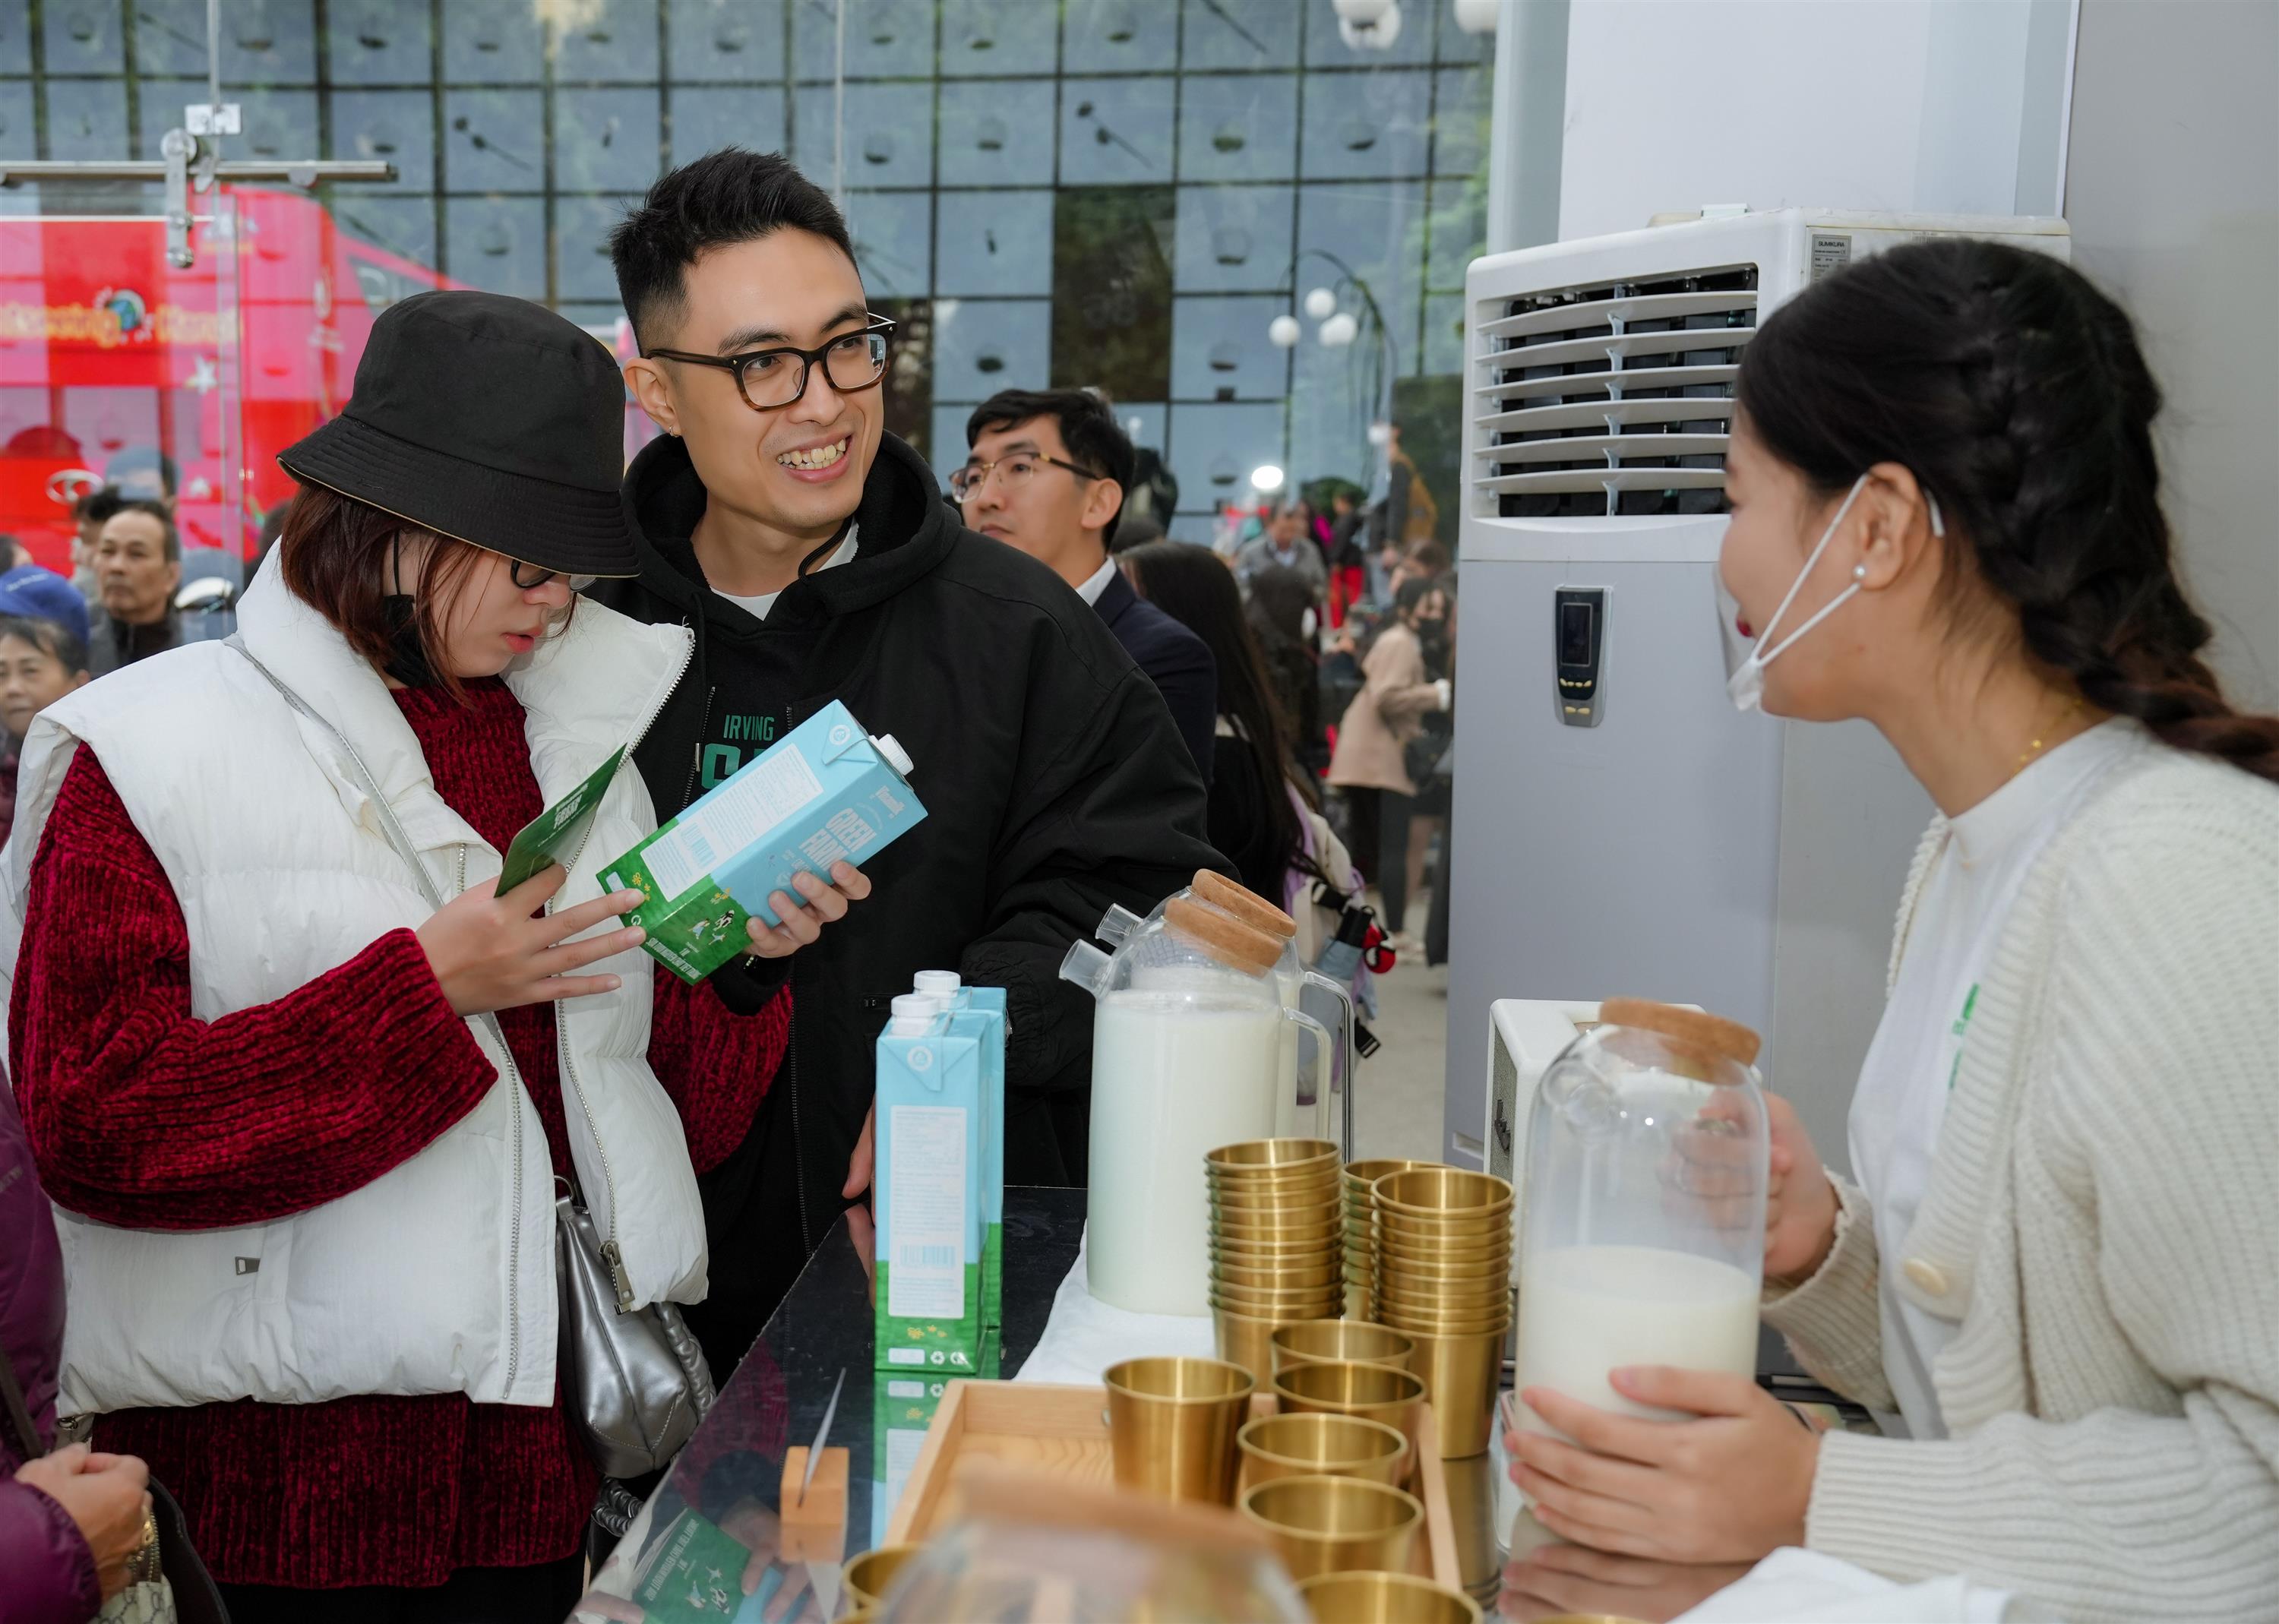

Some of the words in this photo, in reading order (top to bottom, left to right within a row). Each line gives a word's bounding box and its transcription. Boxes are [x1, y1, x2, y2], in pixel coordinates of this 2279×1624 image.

[723, 715, 775, 741] IRVING
[798, 828, 849, 871] FARM
[826, 807, 877, 852] GREEN
